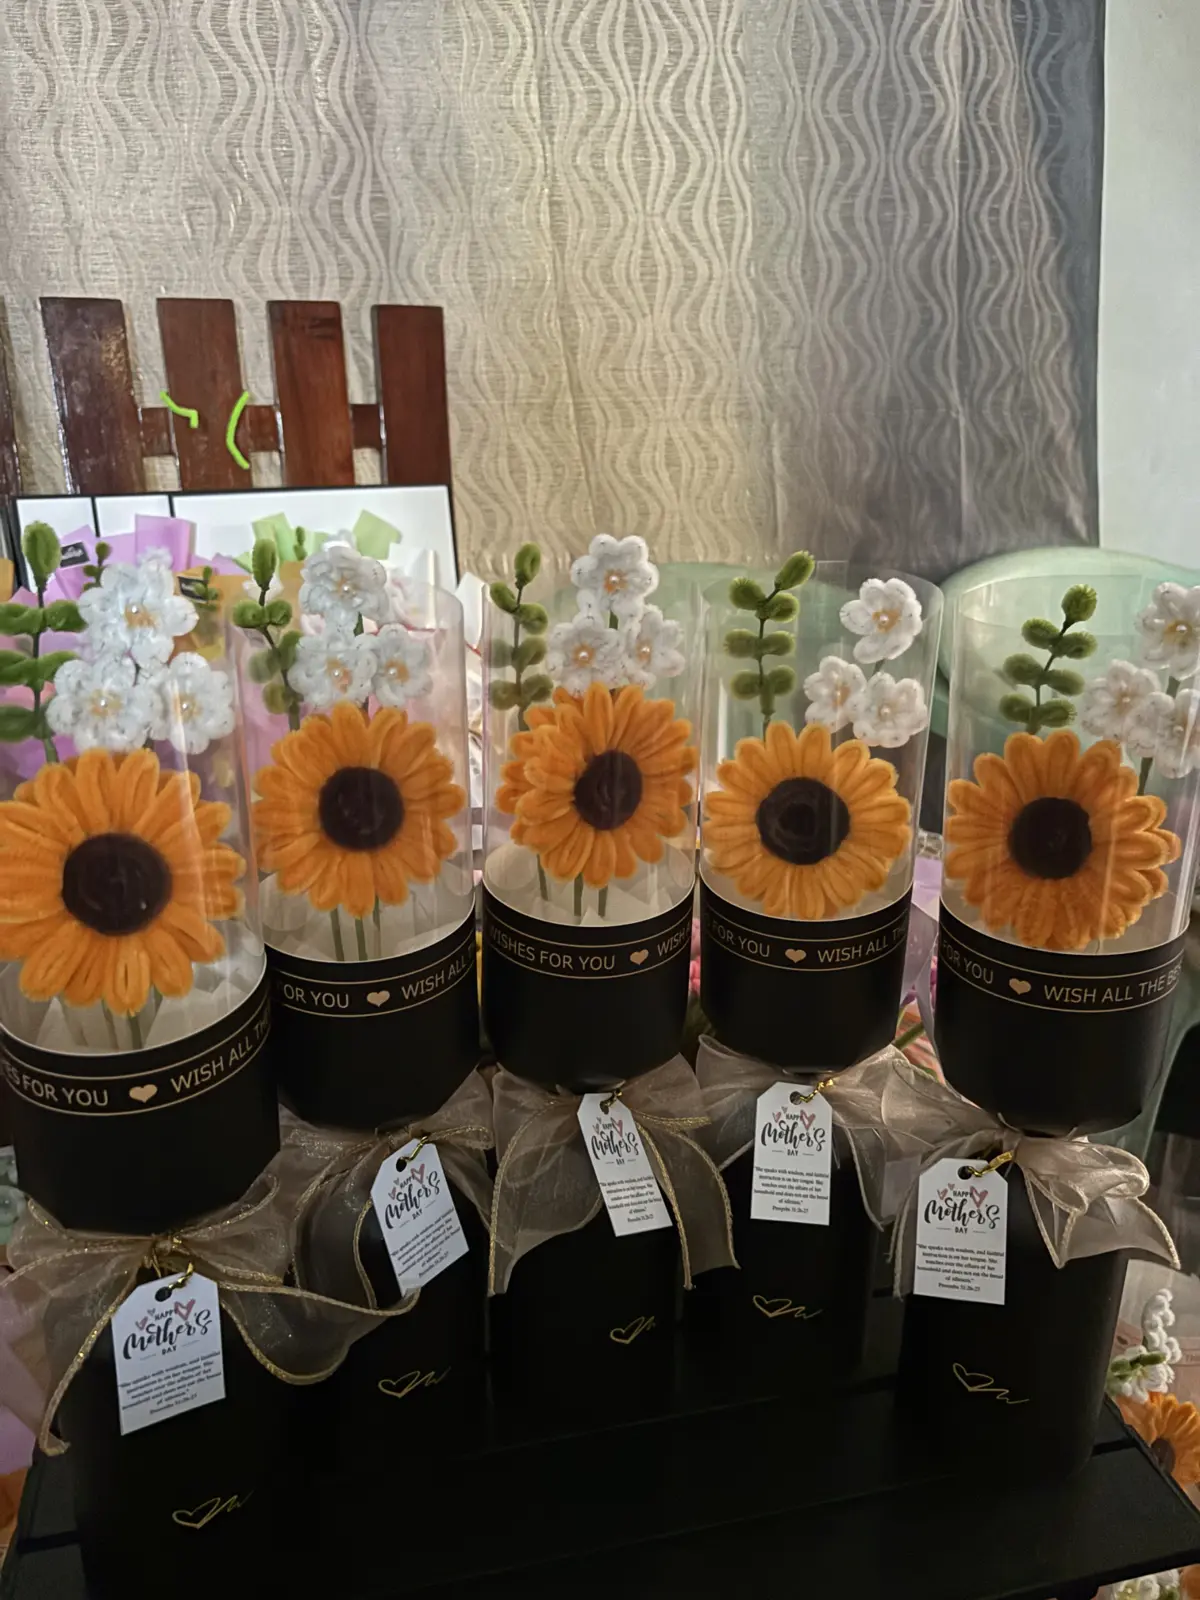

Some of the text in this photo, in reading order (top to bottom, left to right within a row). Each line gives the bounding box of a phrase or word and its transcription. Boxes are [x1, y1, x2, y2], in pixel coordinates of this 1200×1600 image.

[539, 951, 574, 972] FOR
[578, 955, 616, 971] YOU
[656, 931, 686, 957] WISH
[738, 936, 770, 958] YOU
[817, 945, 863, 963] WISH
[865, 936, 889, 956] ALL
[310, 990, 349, 1009] YOU
[401, 970, 445, 1000] WISH
[447, 957, 467, 980] ALL
[963, 957, 994, 985] YOU
[1043, 984, 1098, 1004] WISH
[1101, 984, 1134, 1003] ALL
[1138, 975, 1166, 997] THE
[23, 1074, 58, 1102] FOR
[61, 1087, 109, 1107] YOU
[170, 1055, 225, 1094] WISH
[228, 1042, 253, 1068] ALL
[787, 1149, 799, 1157] DAY
[412, 1209, 423, 1221] DAY
[161, 1345, 177, 1356] DAY
